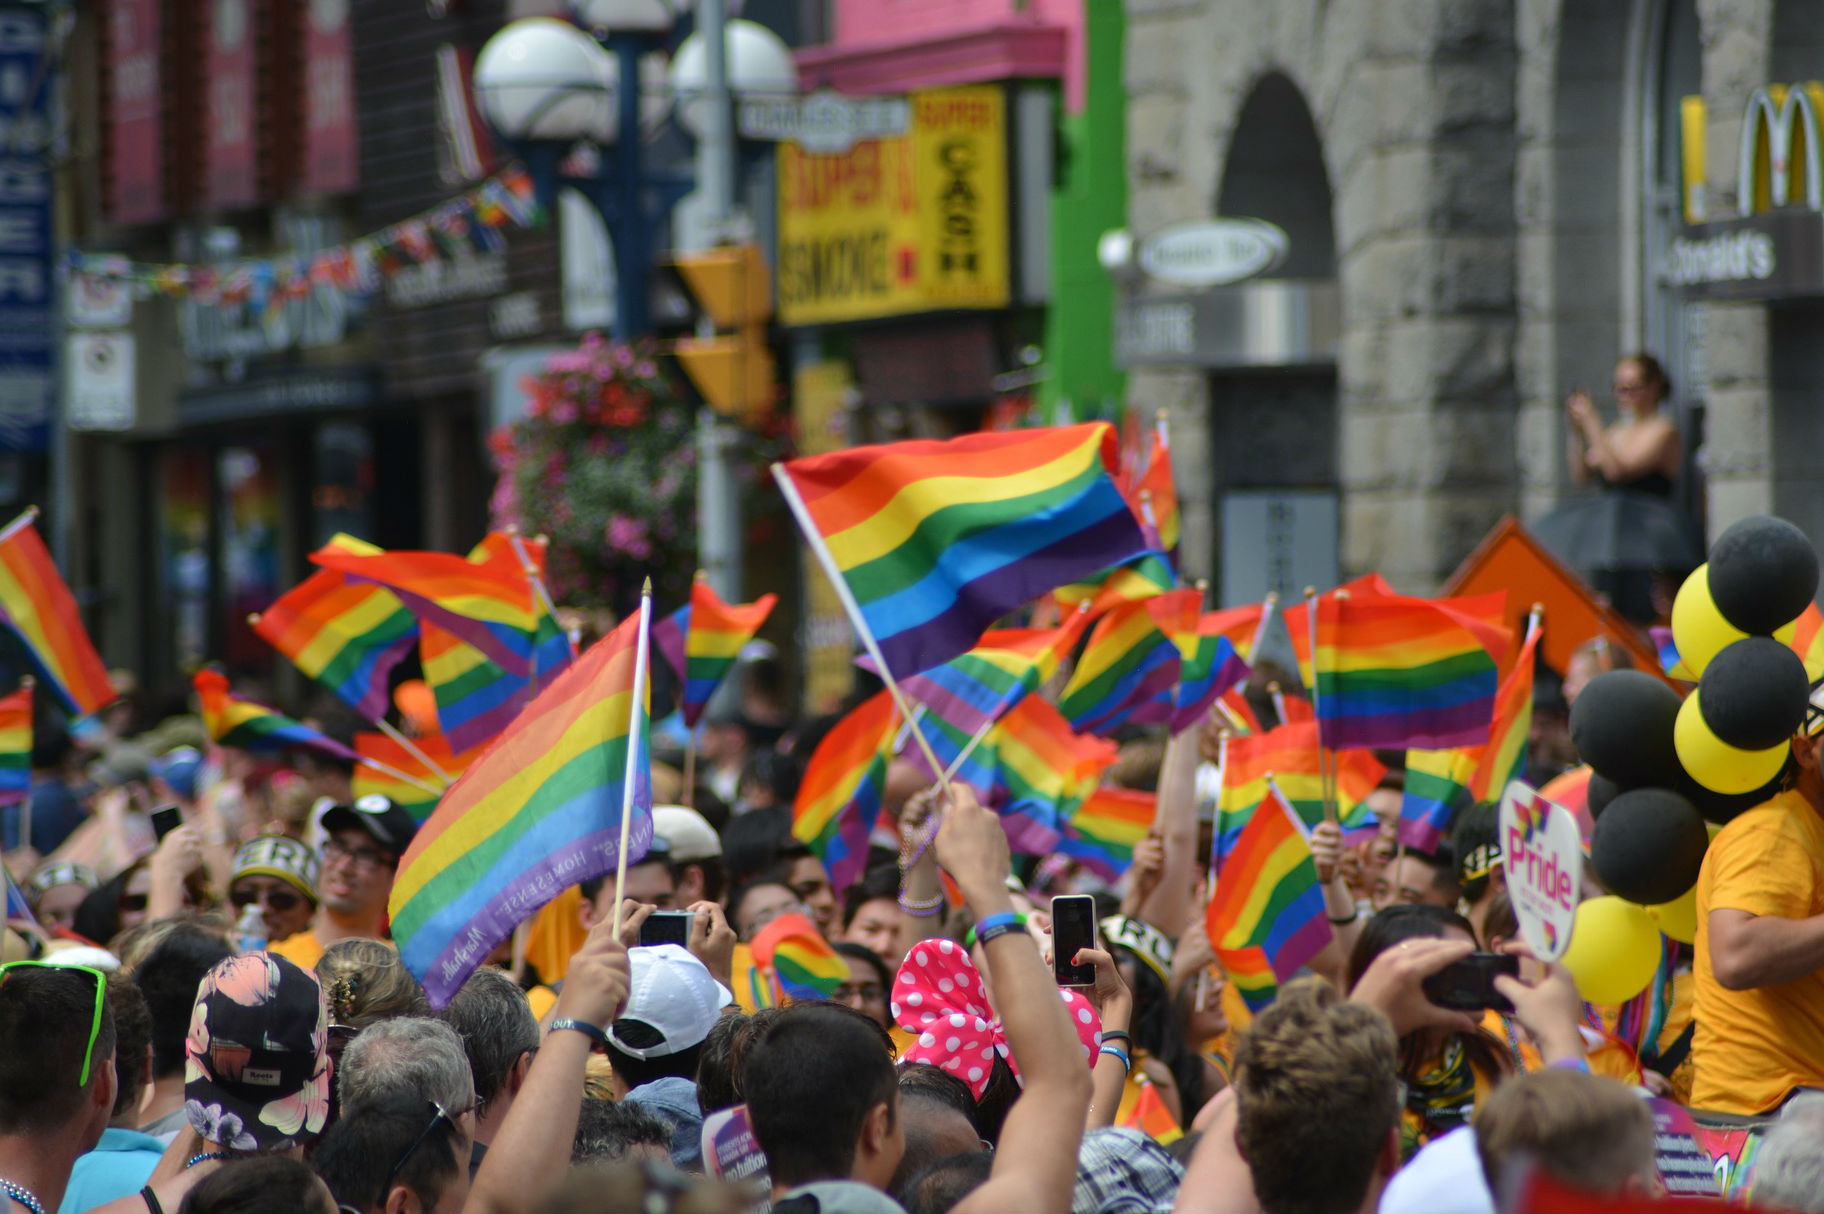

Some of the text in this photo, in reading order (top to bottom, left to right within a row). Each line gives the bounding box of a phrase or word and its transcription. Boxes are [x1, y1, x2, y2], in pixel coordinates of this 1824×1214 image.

[936, 140, 980, 281] CASH
[780, 225, 889, 301] SMOKE
[1508, 824, 1571, 912] Pride
[737, 1151, 768, 1178] tuition
